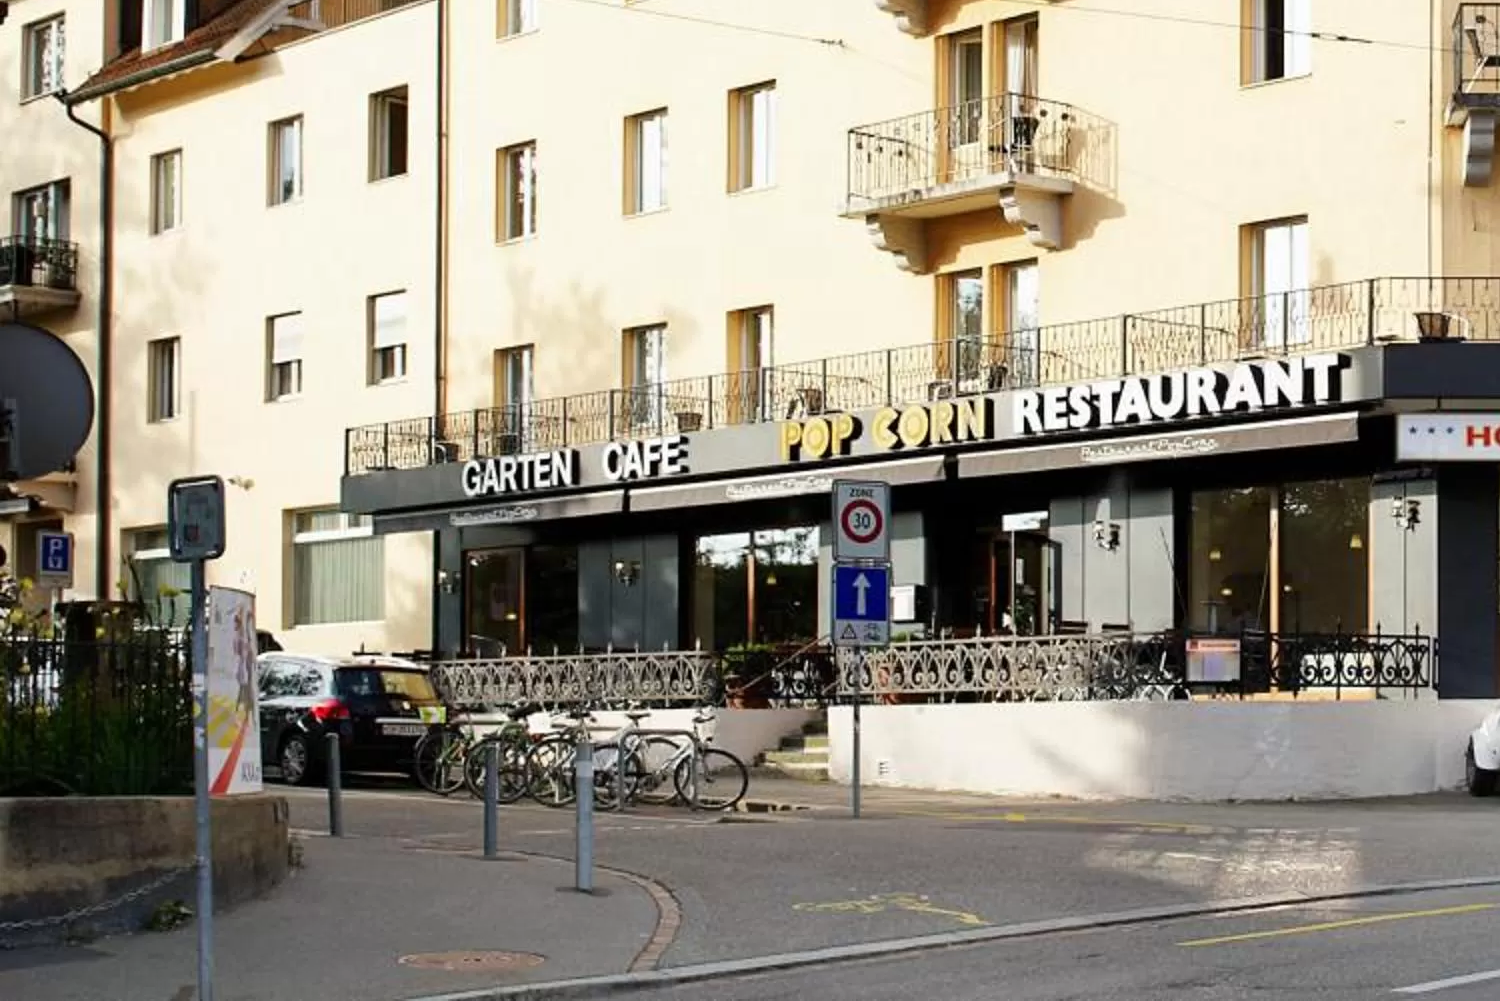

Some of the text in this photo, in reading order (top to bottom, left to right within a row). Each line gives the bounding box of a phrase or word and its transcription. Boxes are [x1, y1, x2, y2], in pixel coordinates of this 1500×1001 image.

[460, 352, 1343, 497] GARTEN CAFE POP CORN RESTAURANT
[849, 487, 874, 498] ZONE
[852, 512, 871, 530] 30
